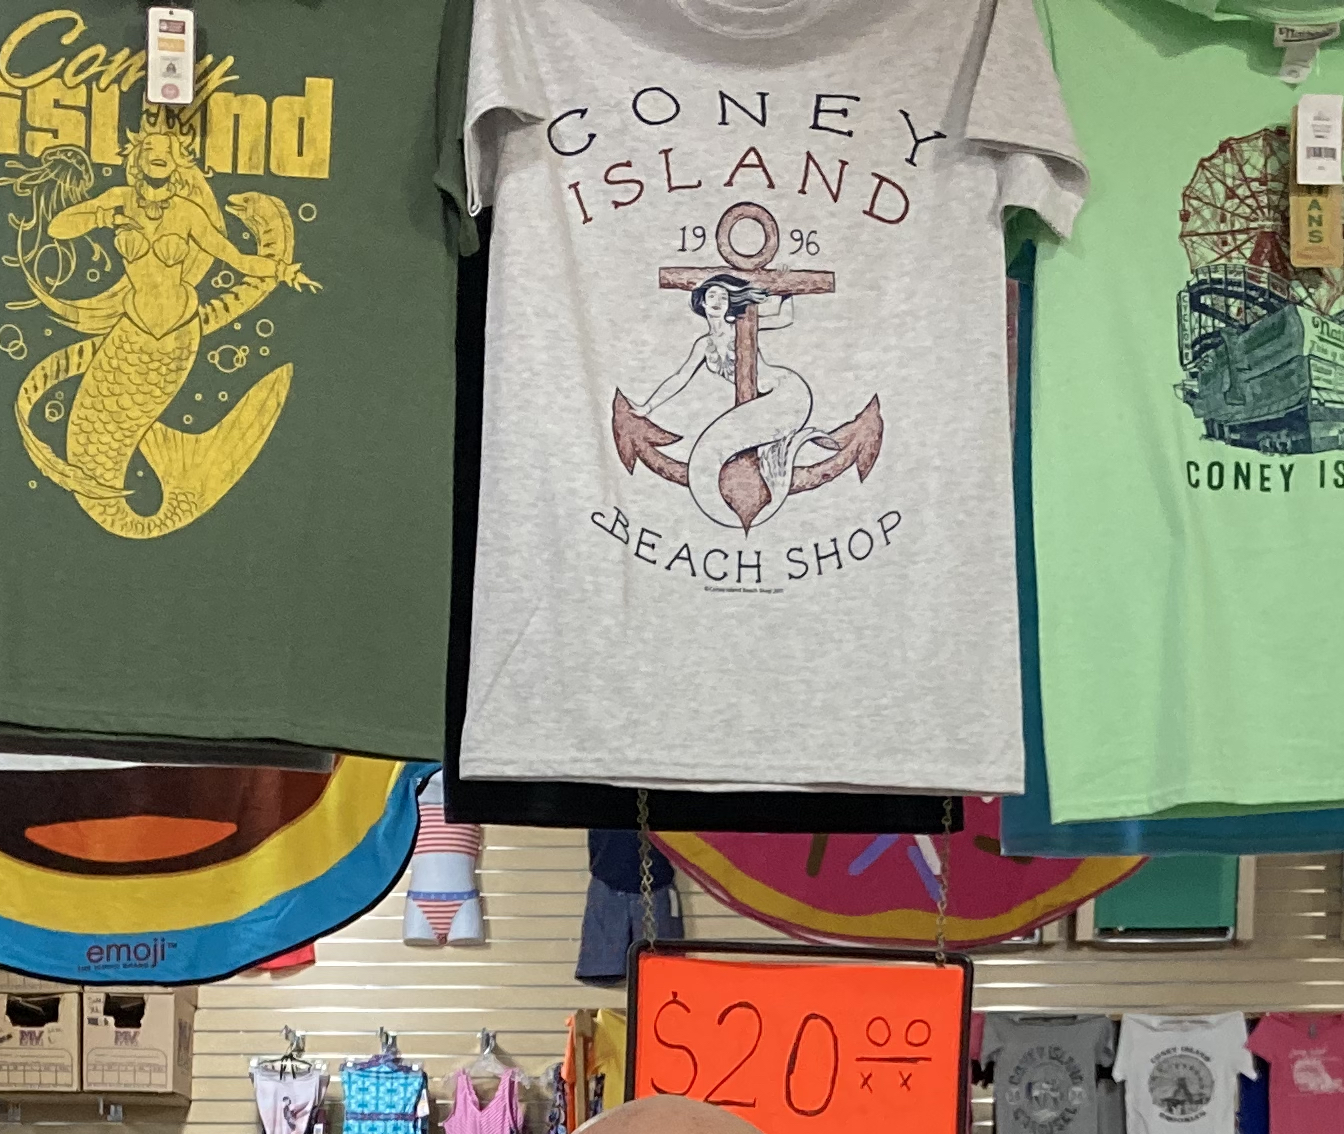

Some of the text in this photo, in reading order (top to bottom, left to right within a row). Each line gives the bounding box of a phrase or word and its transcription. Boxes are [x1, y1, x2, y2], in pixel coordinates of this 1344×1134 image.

[546, 86, 947, 167] CONEY
[568, 146, 911, 224] ISLAND
[677, 226, 820, 256] 19 96
[1186, 459, 1296, 492] CONEY
[591, 506, 902, 584] BEACH SHOP
